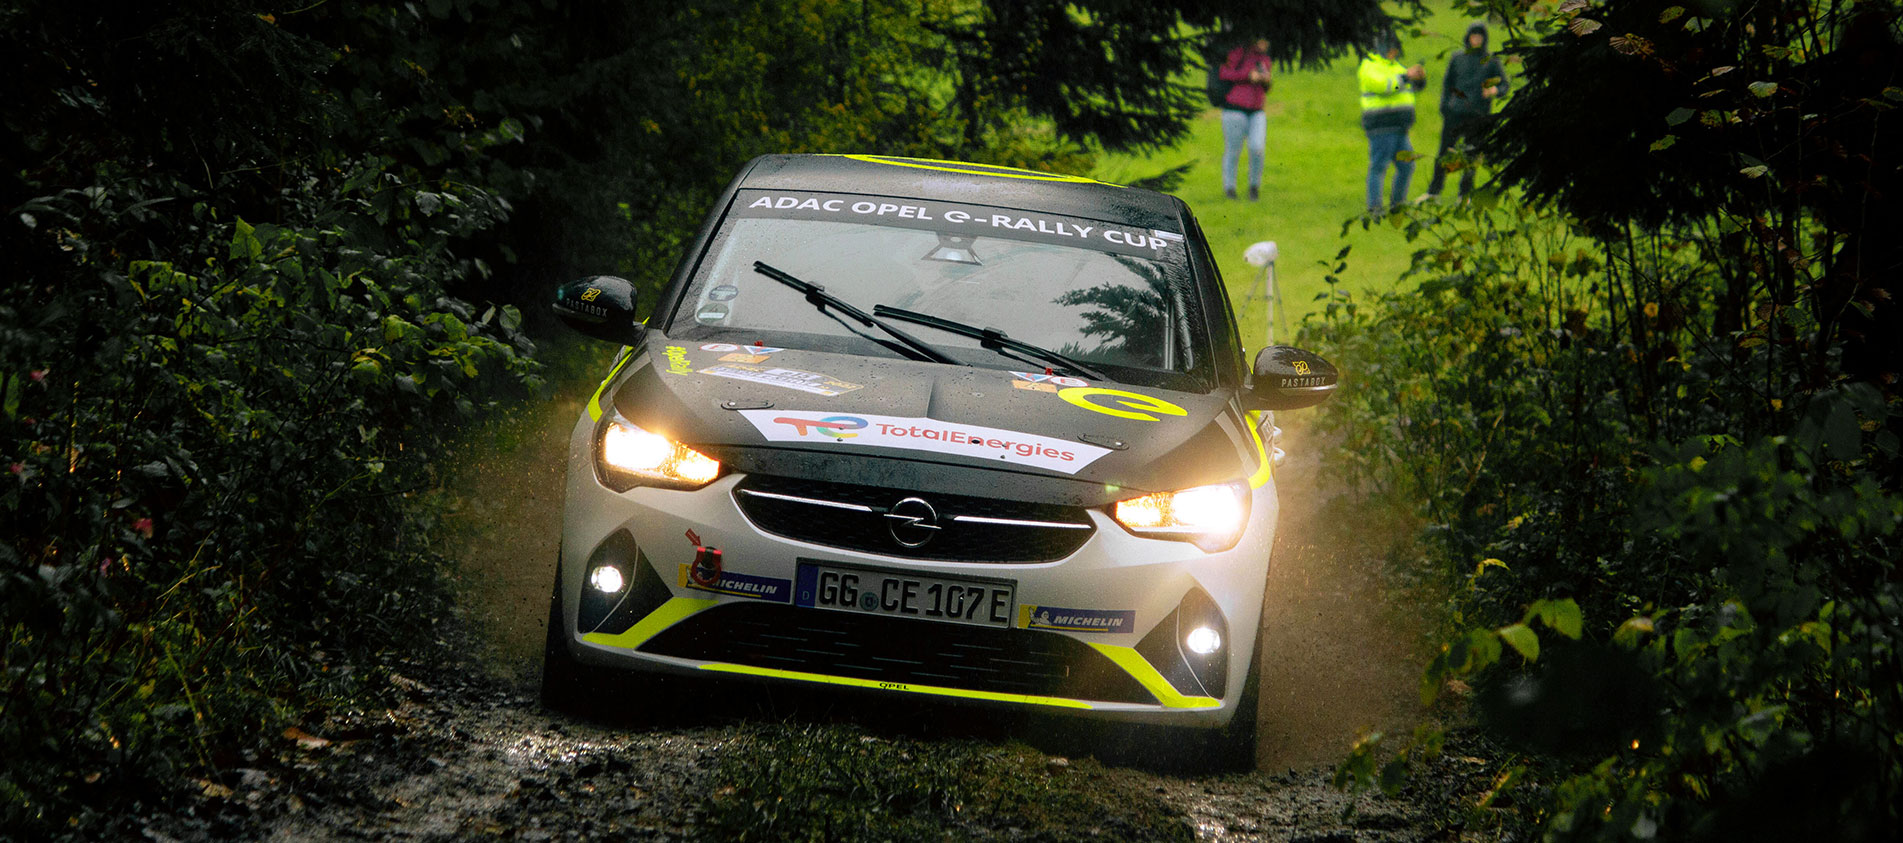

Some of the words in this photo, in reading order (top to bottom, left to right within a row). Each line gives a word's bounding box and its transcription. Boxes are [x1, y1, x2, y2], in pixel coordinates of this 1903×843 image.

[749, 196, 844, 212] ADAC
[851, 201, 933, 221] OPEL
[1103, 230, 1168, 251] CUP
[564, 297, 608, 318] PASTABOX
[1281, 376, 1326, 387] PASTABOX
[876, 423, 1075, 462] TotalEnergies
[711, 578, 778, 594] ICHELIN
[802, 591, 810, 600] D
[818, 572, 859, 607] GG
[880, 578, 920, 614] CE
[926, 583, 985, 620] 107
[990, 590, 1009, 623] E
[1053, 614, 1124, 628] MICHELIN
[879, 682, 910, 690] OPEL
